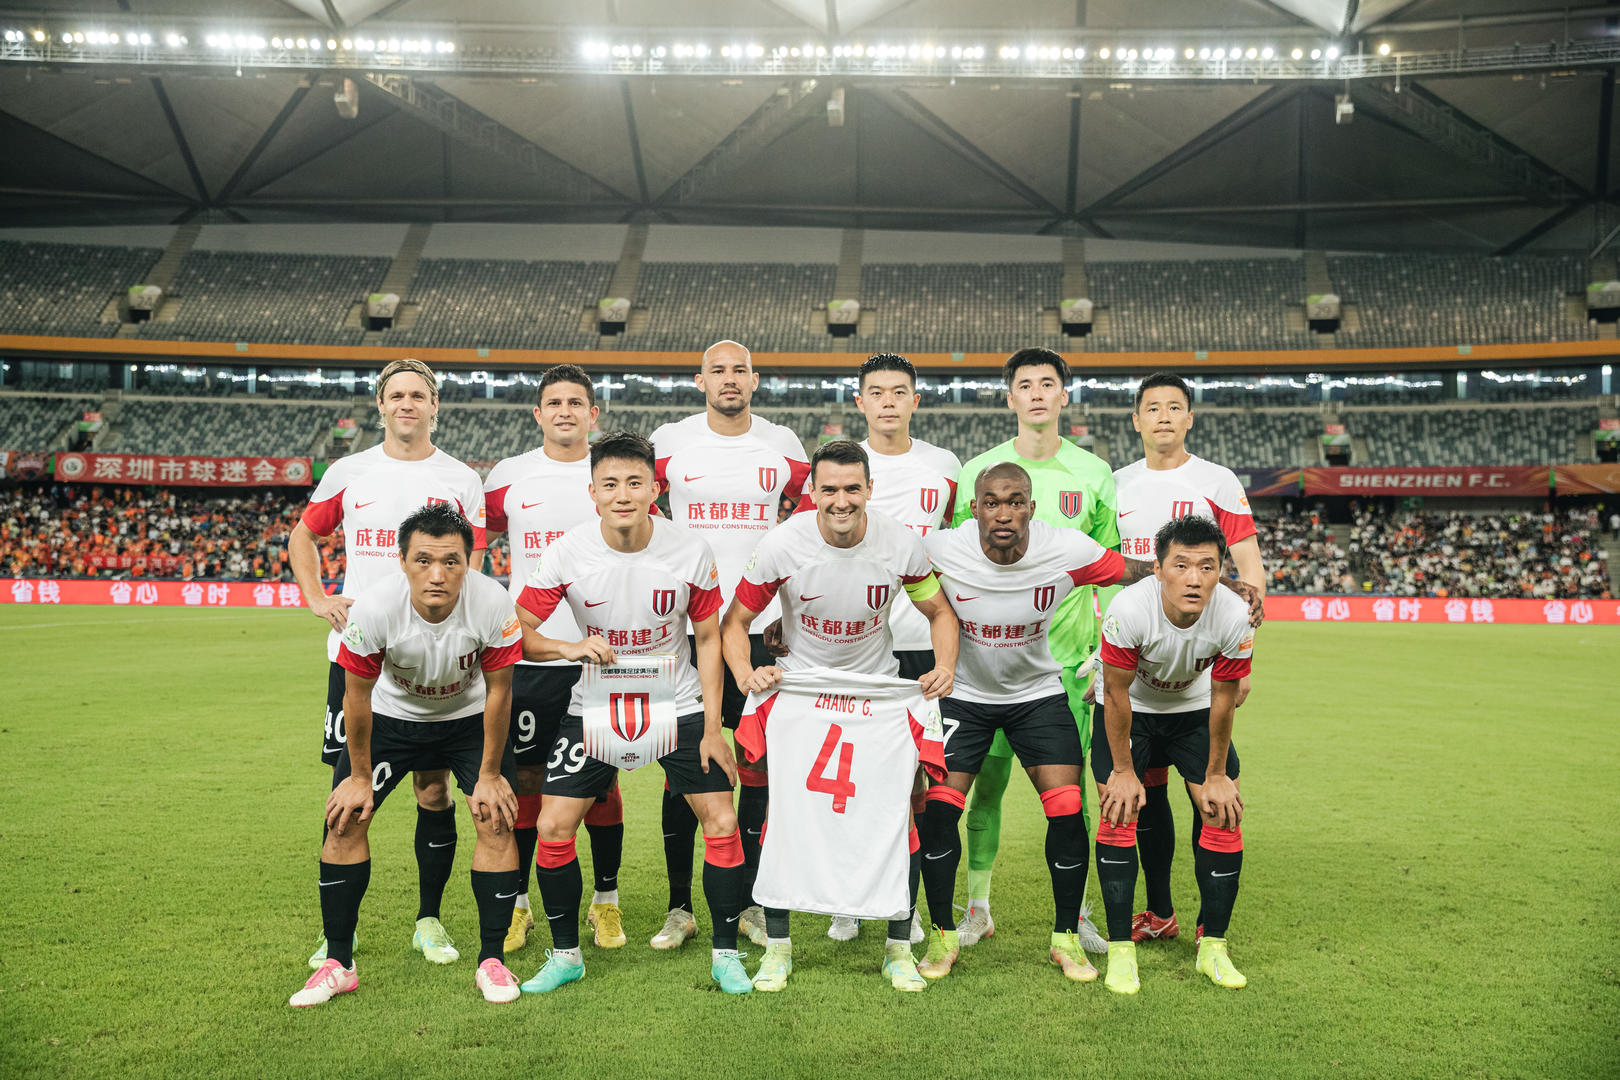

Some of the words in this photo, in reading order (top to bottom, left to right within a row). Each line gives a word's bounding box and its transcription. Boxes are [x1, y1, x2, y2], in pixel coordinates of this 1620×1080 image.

[608, 308, 624, 321] 26
[93, 456, 277, 482] 深圳市球迷会
[1339, 474, 1462, 488] SHENZHEN
[1469, 473, 1511, 488] F.C.
[688, 502, 770, 521] 成都建工
[721, 523, 769, 531] CONSTRUCTION
[355, 550, 386, 558] CHENGDU
[11, 580, 61, 603] 省钱
[110, 582, 158, 604] 省心
[182, 582, 230, 605] 省时
[253, 584, 301, 606] 省钱
[1301, 597, 1350, 620] 省心
[1372, 598, 1422, 621] 省时
[1444, 599, 1494, 622] 省钱
[1543, 600, 1593, 623] 省心
[801, 611, 883, 636] 成都建工
[834, 626, 883, 644] CONSTRUCTION
[959, 618, 1047, 639] 成都建工
[993, 635, 1044, 648] CONSTRUCTION
[815, 692, 857, 713] ZHANG
[862, 698, 874, 717] G.
[518, 710, 536, 742] 9
[547, 737, 587, 773] 39
[806, 723, 856, 814] 4
